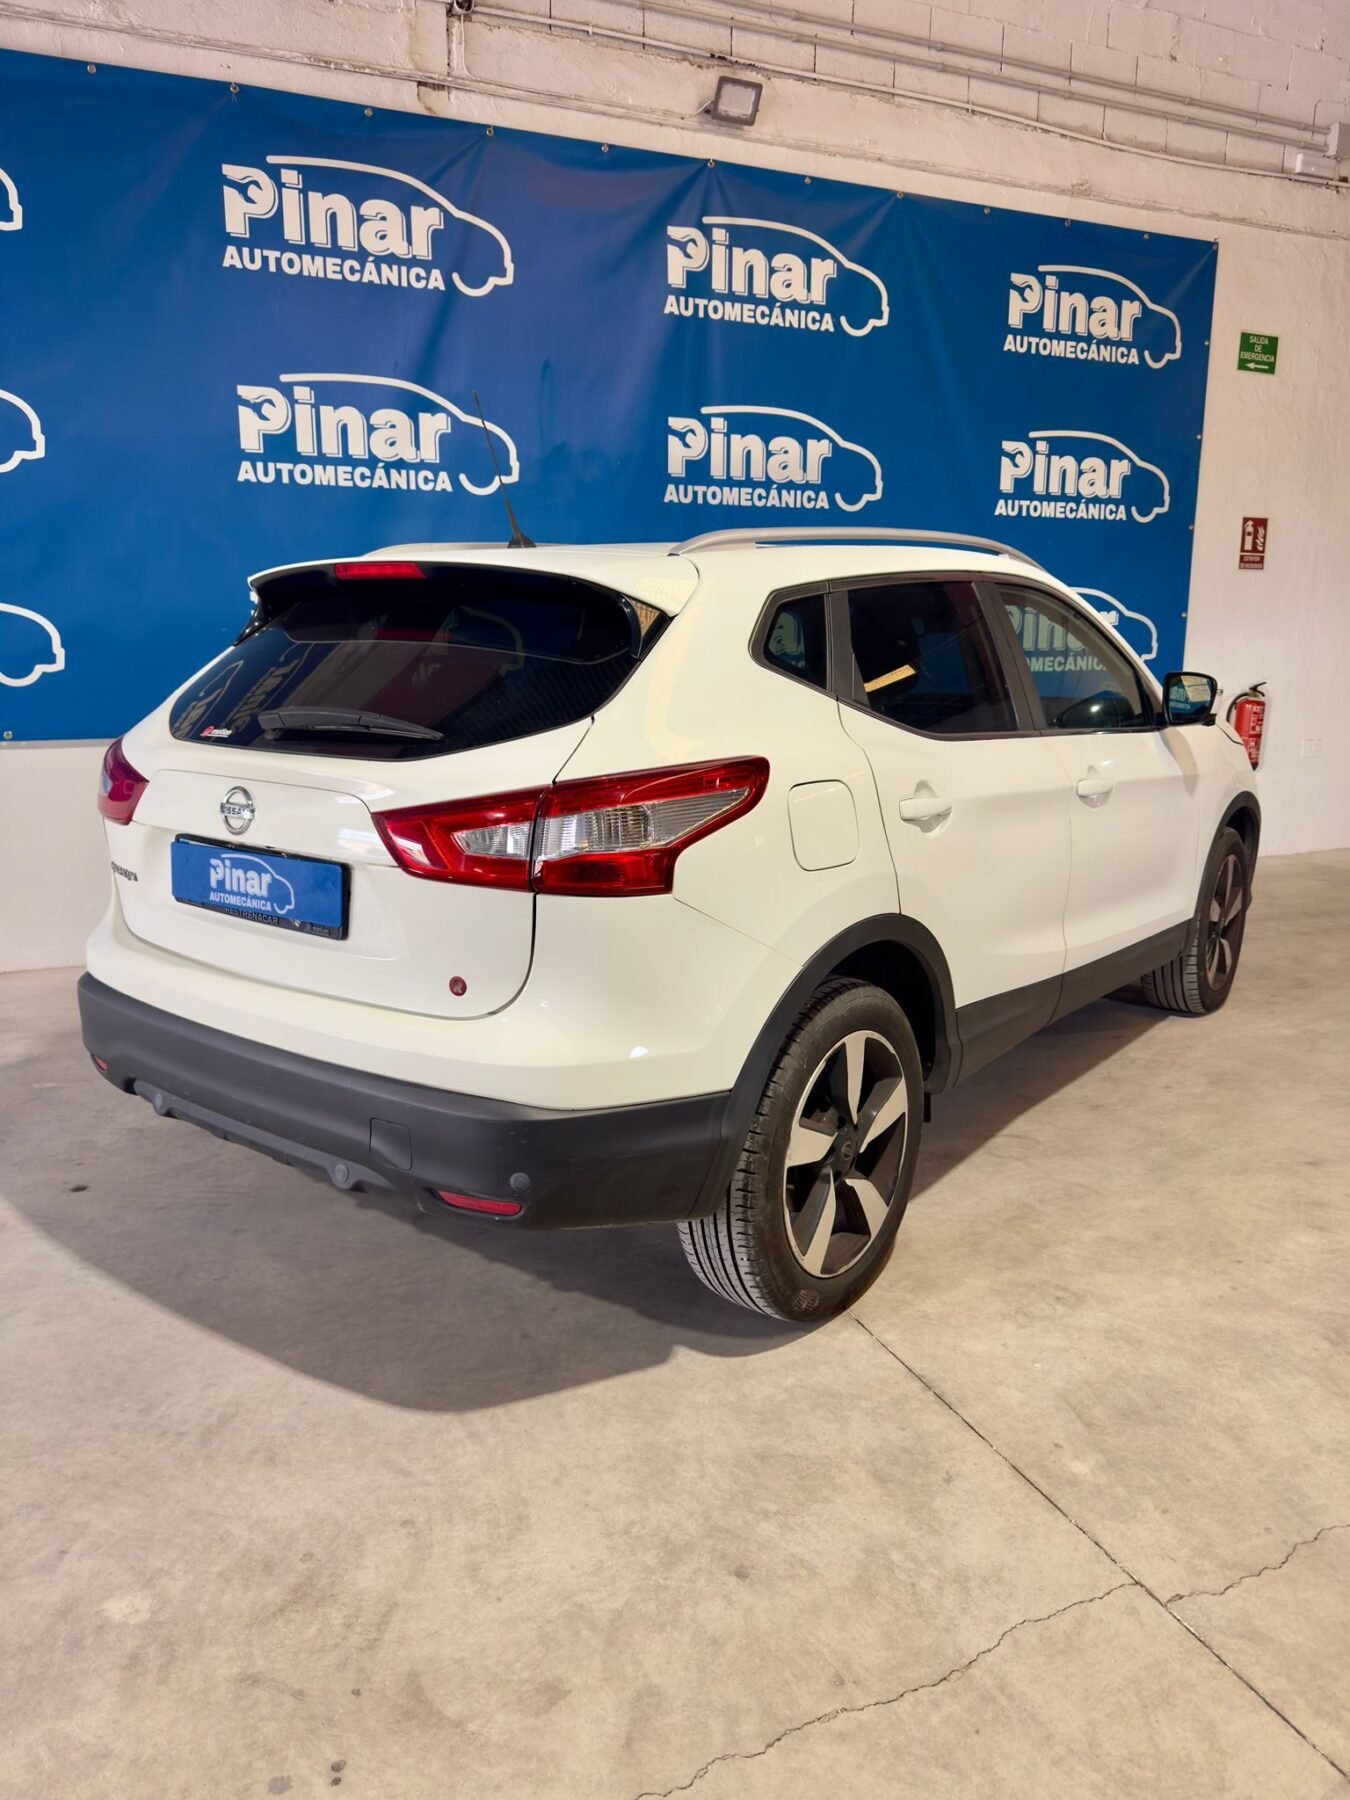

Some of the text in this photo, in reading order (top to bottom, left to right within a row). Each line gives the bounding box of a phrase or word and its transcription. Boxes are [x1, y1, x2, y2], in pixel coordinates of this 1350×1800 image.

[222, 163, 444, 261] Pinar
[222, 245, 446, 290] AUTOMECÁNICA
[666, 225, 838, 306] Pinar
[663, 294, 835, 333] AUTOMECÁNICA
[1007, 272, 1143, 342] Pinar
[1003, 334, 1140, 365] AUTOMECÁNICA
[1249, 335, 1269, 345] SALIDA
[1254, 344, 1262, 353] DE
[236, 384, 452, 464] Pinar
[667, 416, 833, 485] Pinar
[999, 440, 1132, 499] Pinar
[237, 460, 453, 492] AUTOMECÁNICA
[663, 483, 830, 509] AUTOMECÁNICA
[994, 498, 1127, 521] AUTOMECÁNICA
[209, 858, 272, 897] Pinar
[209, 891, 272, 911] AUTOMECÁNICA
